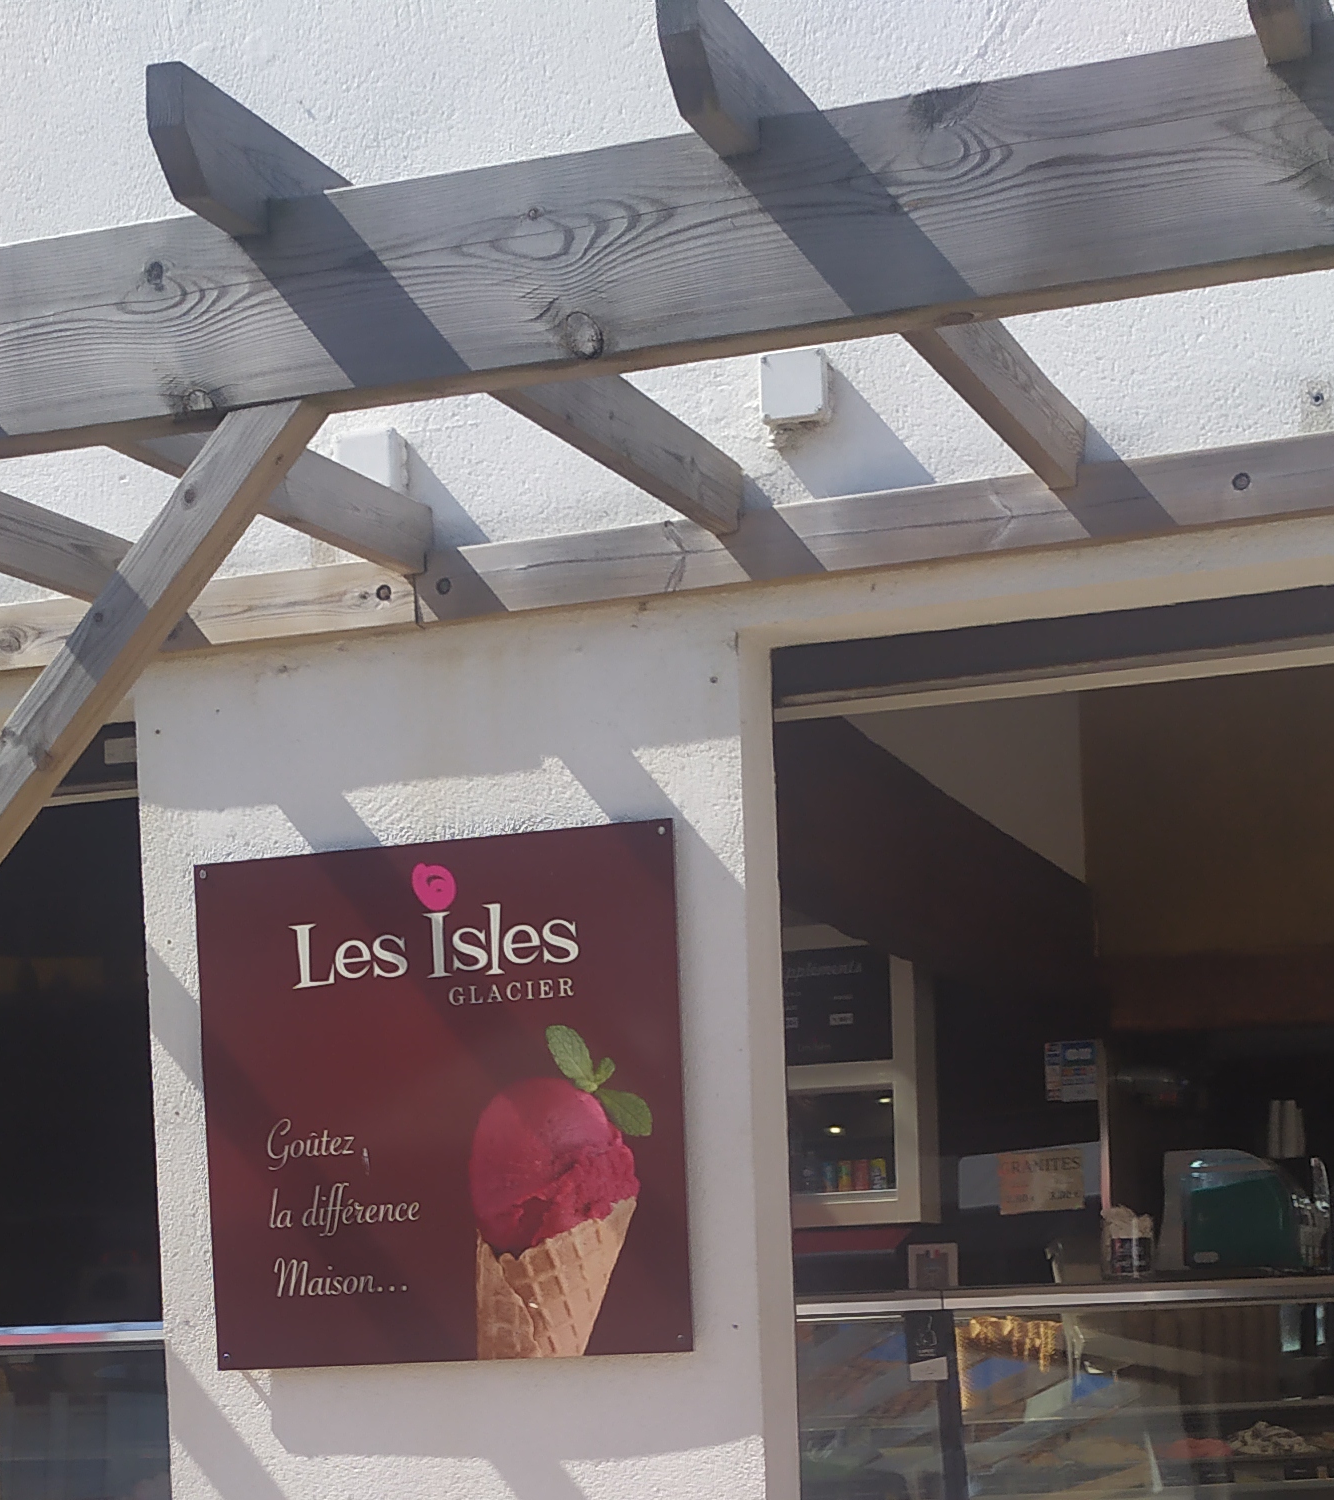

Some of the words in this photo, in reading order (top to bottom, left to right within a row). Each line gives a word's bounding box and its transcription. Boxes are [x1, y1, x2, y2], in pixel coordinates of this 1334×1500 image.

[288, 922, 409, 990] Les
[422, 902, 580, 978] Isles
[448, 977, 576, 1006] GLACIER
[269, 1187, 294, 1229] la
[302, 1182, 421, 1237] différence
[273, 1257, 409, 1298] Maison...
